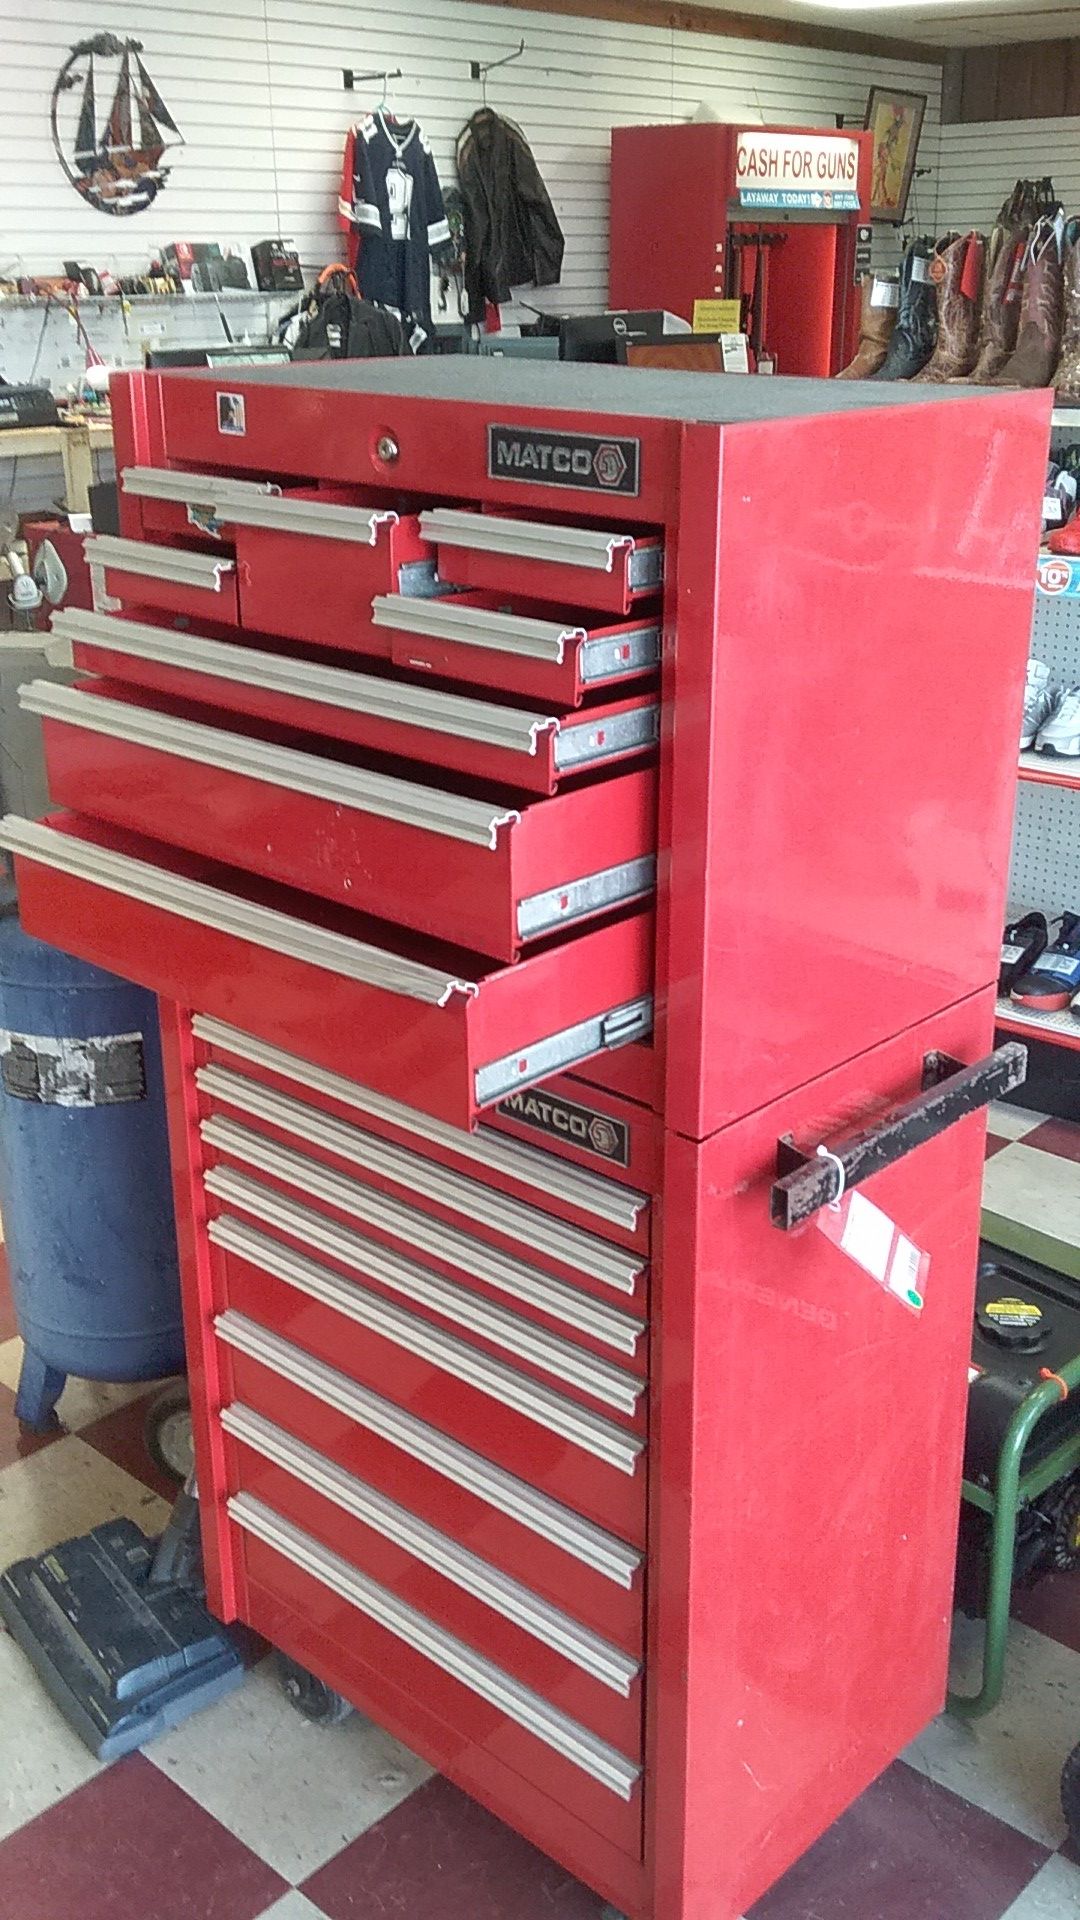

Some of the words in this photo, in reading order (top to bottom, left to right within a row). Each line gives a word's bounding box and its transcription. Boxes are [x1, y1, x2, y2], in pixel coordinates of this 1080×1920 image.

[736, 146, 778, 177] CASH
[783, 149, 813, 178] FOR
[816, 151, 856, 180] GUNS
[741, 191, 779, 204] LAYAWAY
[497, 440, 592, 475] MATCO
[504, 1094, 588, 1138] MATCO
